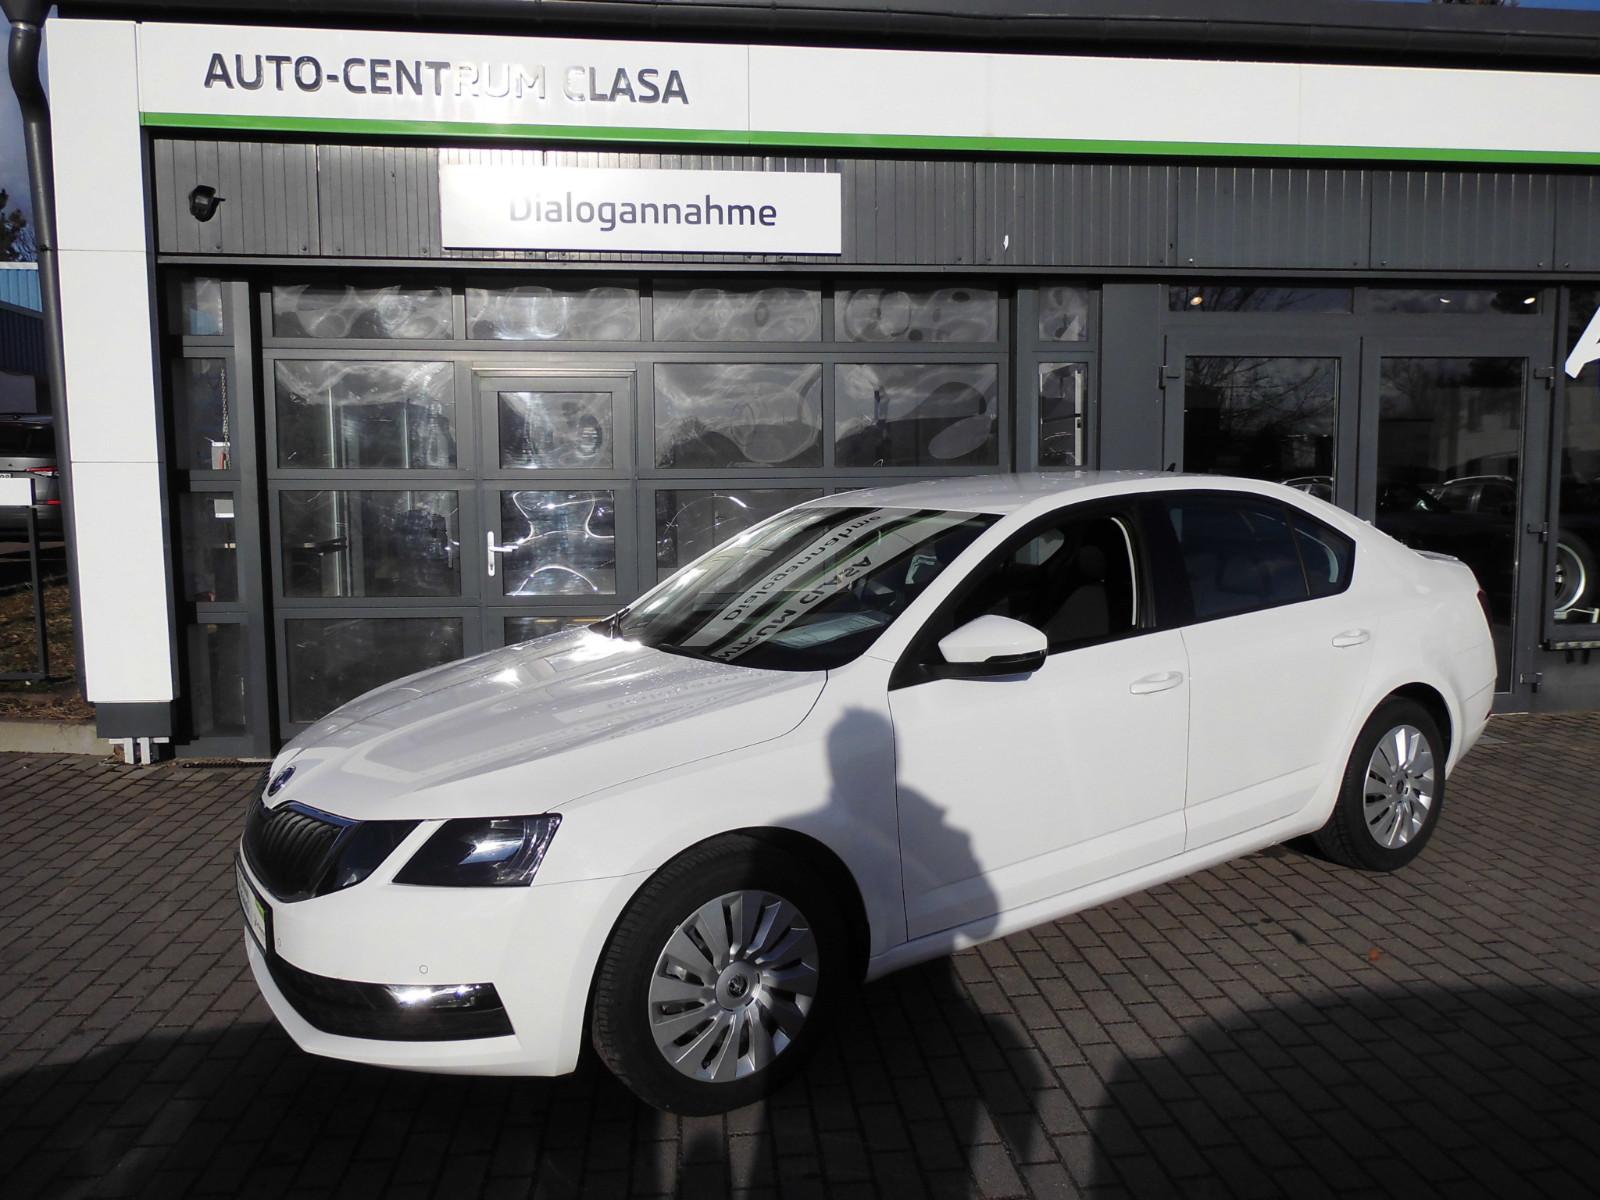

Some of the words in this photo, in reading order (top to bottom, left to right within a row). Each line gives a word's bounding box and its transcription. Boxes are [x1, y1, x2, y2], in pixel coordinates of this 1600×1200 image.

[204, 52, 546, 100] AUTO-CENTRUM
[562, 66, 689, 105] CLASA
[509, 192, 777, 232] Dialogannahme
